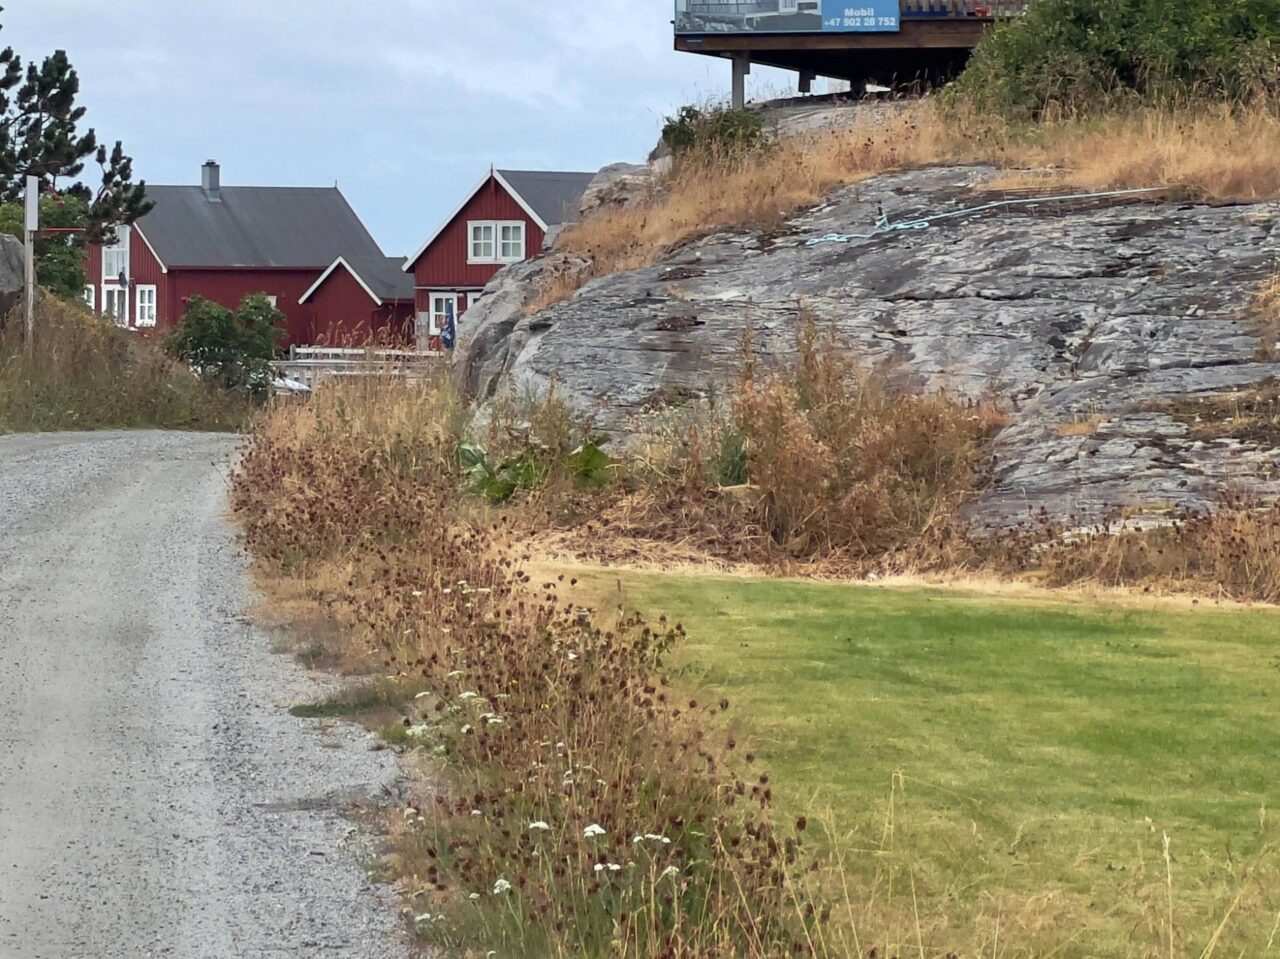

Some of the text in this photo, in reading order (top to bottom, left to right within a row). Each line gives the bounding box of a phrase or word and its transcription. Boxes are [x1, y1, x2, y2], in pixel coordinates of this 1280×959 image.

[844, 8, 874, 17] Mobil
[824, 18, 841, 27] +47
[844, 18, 861, 27] 902
[878, 17, 896, 26] 752
